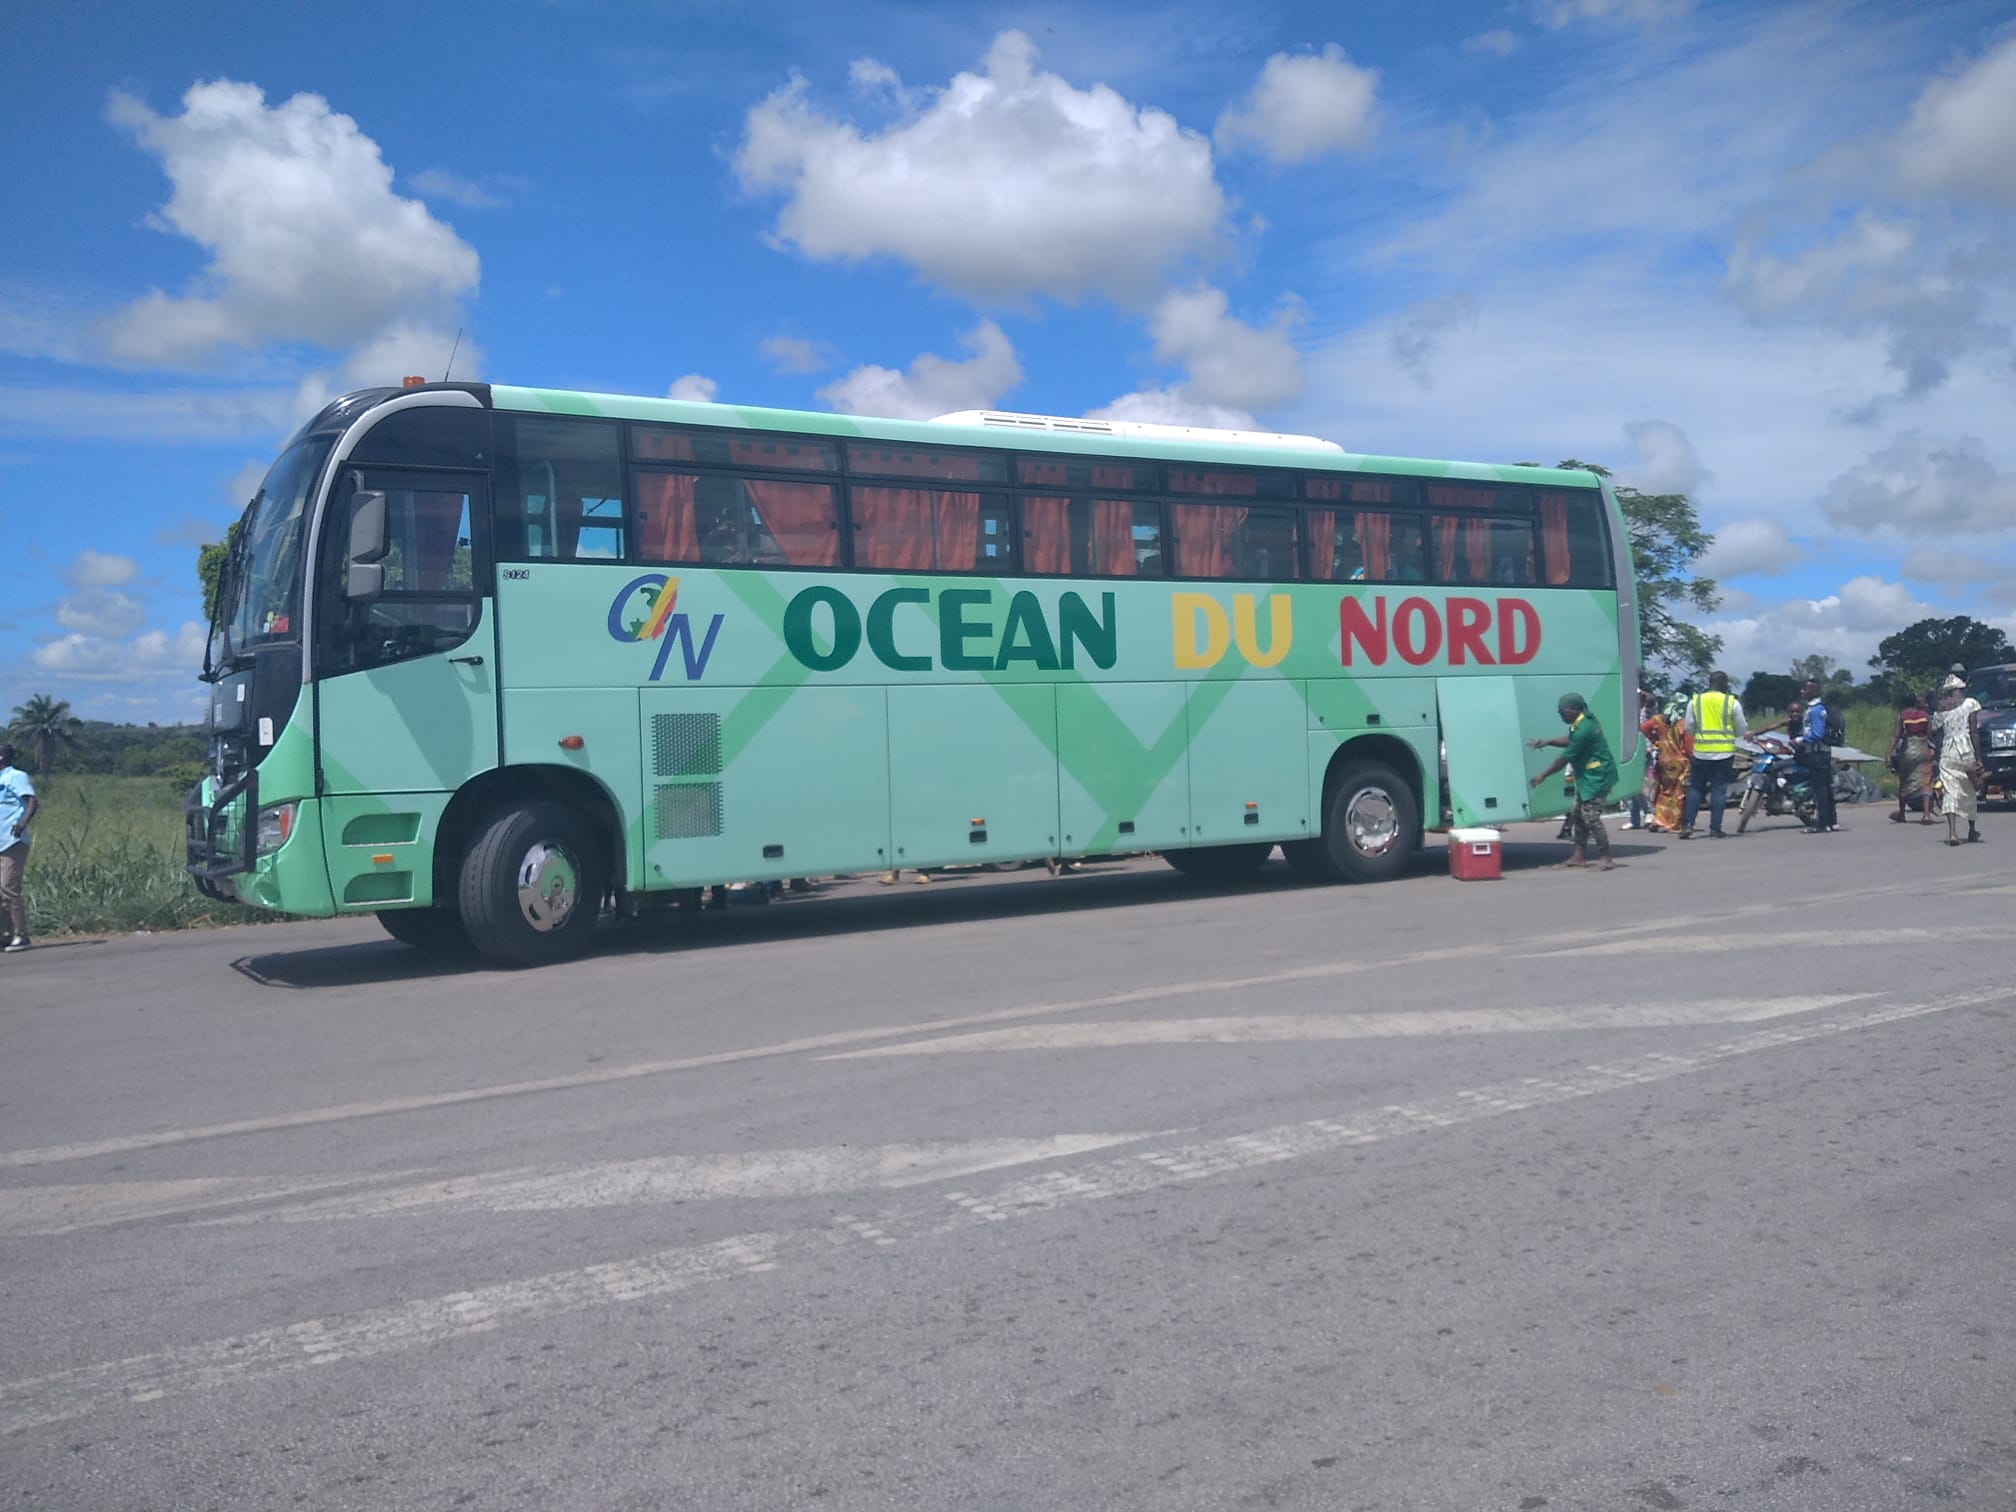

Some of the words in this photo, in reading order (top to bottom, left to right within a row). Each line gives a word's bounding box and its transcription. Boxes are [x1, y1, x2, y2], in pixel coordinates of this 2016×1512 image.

[783, 585, 1117, 671] OCEAN
[1172, 592, 1292, 669] DU
[1339, 595, 1542, 667] NORD
